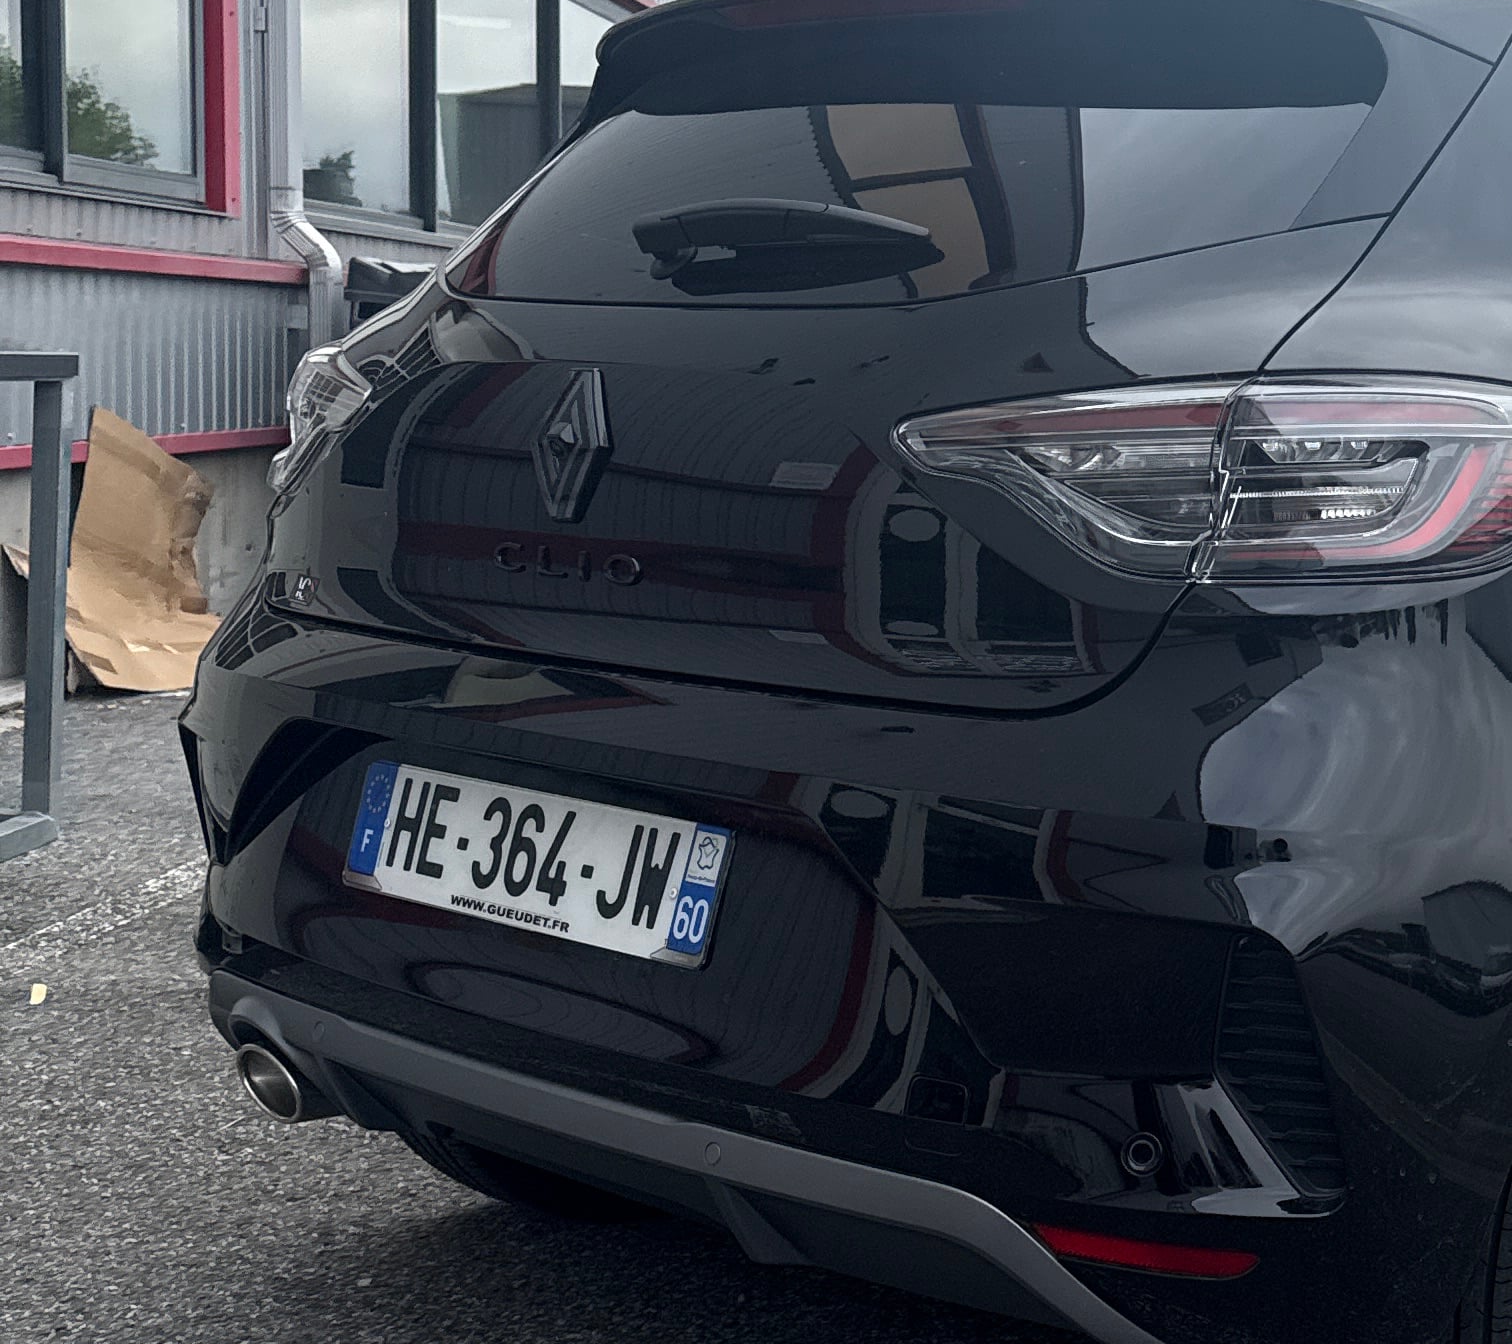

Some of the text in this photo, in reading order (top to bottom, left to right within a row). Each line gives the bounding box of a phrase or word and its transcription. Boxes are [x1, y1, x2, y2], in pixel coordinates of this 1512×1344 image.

[495, 542, 643, 586] CLIO
[359, 828, 374, 853] F
[385, 778, 681, 930] HE-364-JW
[450, 894, 570, 933] WWW.GUEUDET.FR
[671, 894, 709, 944] 60
